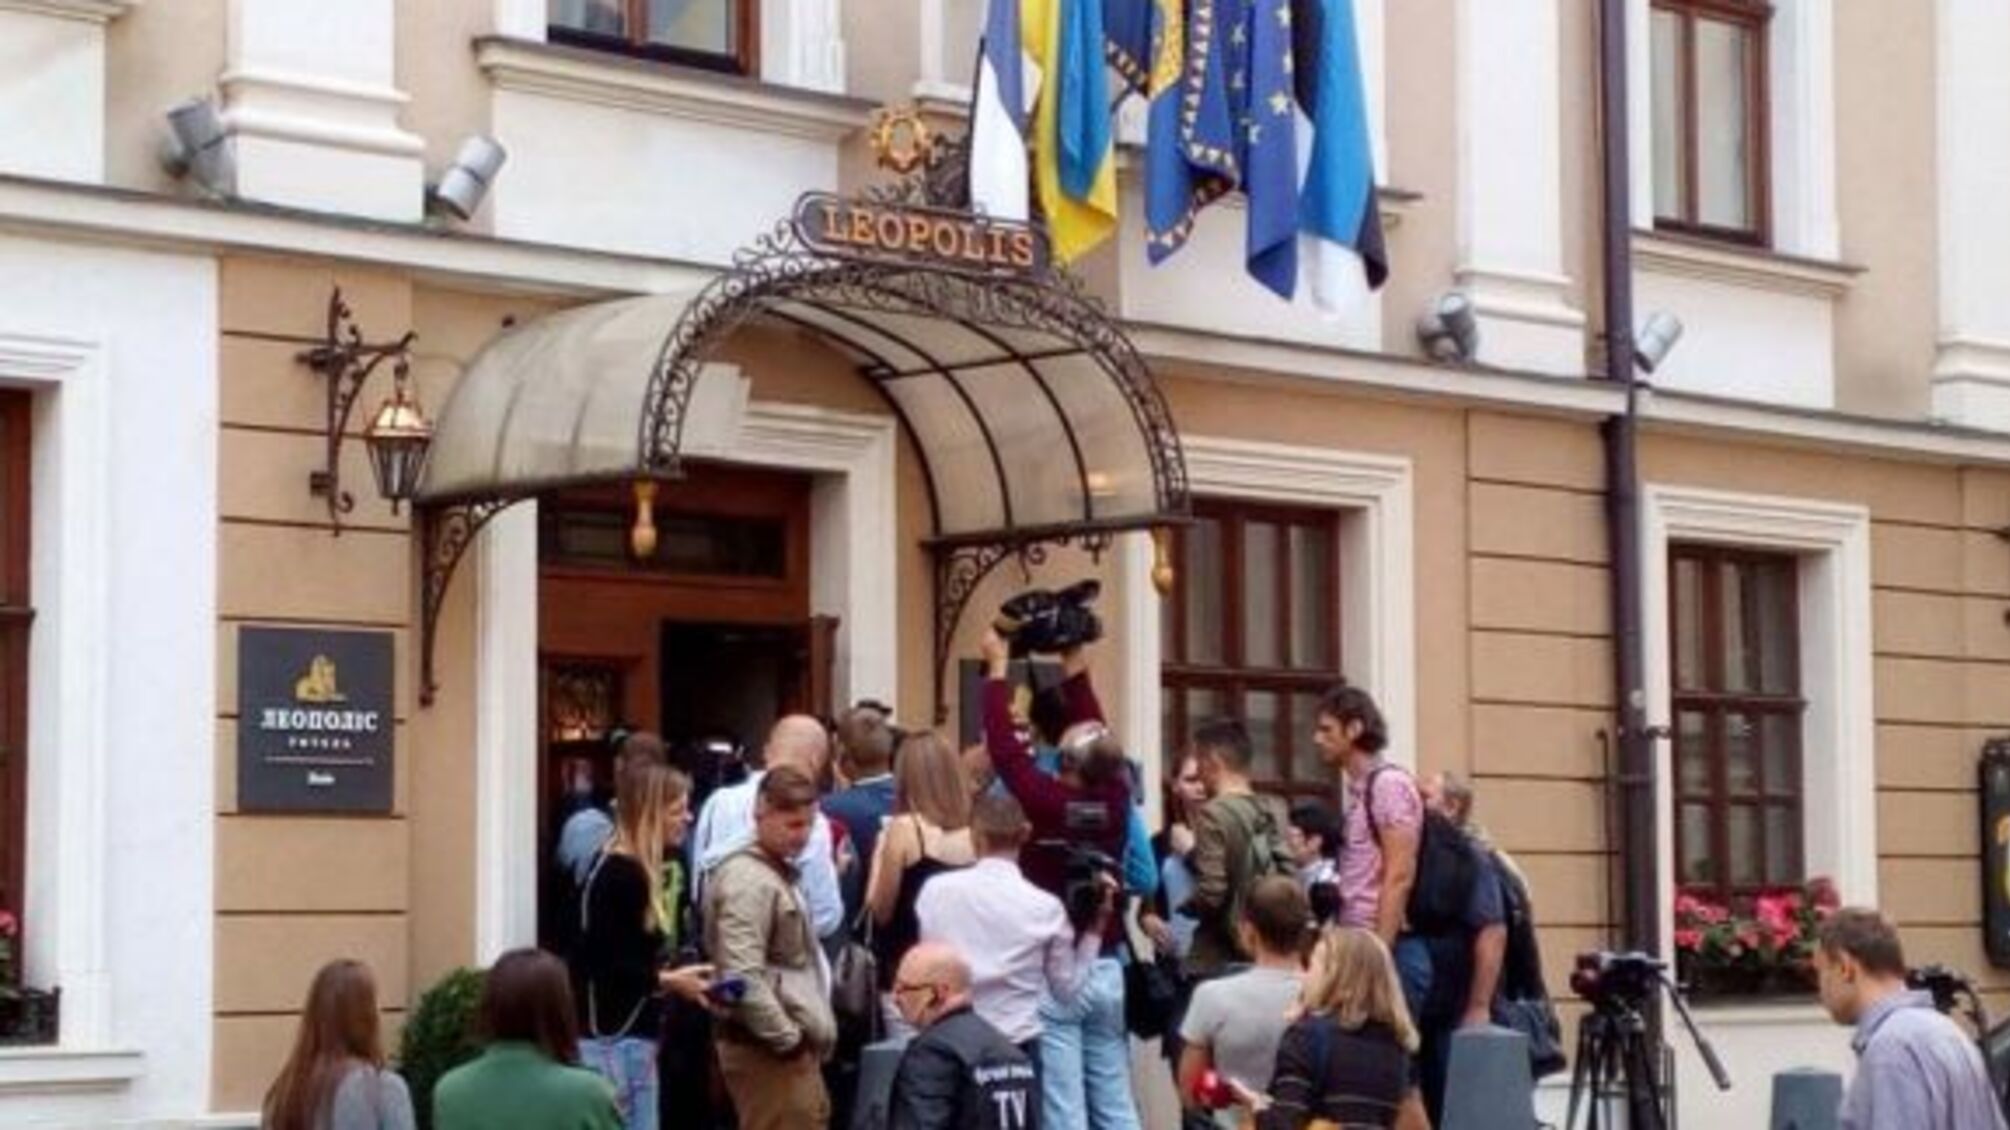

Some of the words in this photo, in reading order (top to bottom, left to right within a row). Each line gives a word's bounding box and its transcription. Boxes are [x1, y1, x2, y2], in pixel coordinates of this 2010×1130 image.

[821, 204, 1035, 266] LEOPOLIS
[260, 708, 379, 732] ЛЕОПОЛІС
[992, 1089, 1027, 1130] TV
